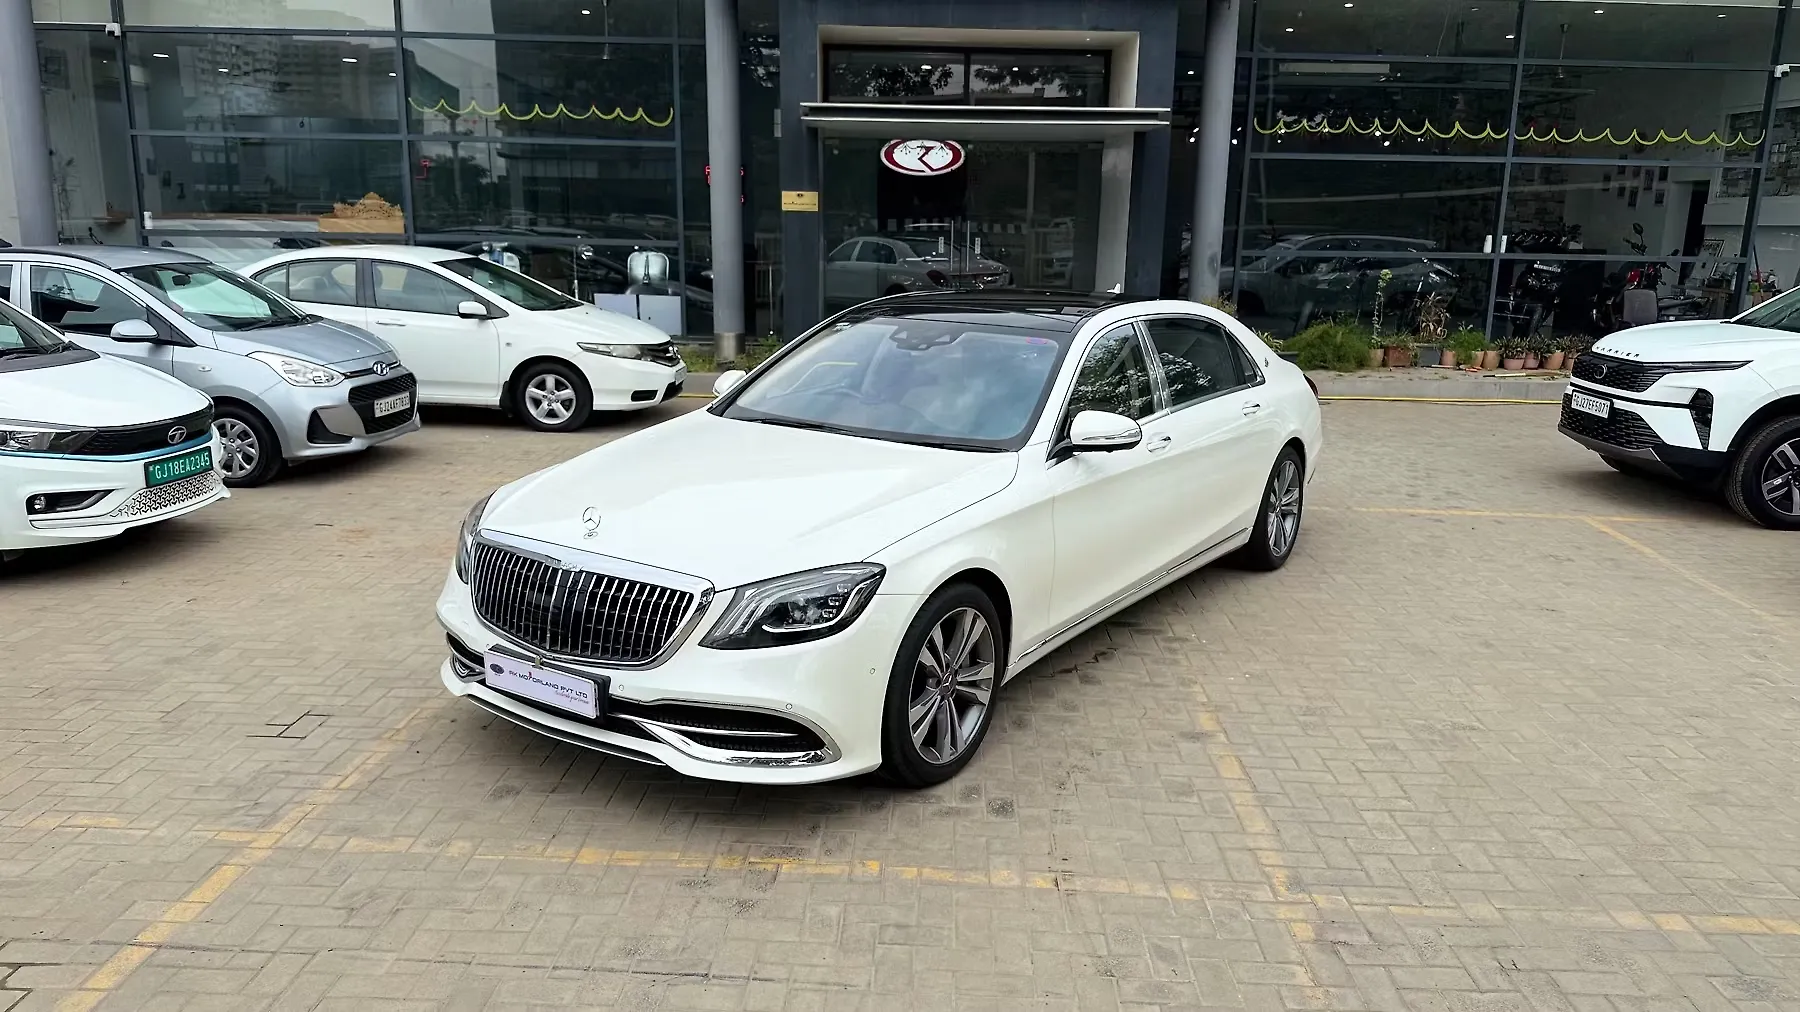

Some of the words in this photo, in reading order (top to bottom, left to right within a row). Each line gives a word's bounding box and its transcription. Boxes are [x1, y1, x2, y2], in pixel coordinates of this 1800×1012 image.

[155, 452, 210, 479] GJ18EA2345
[518, 671, 559, 690] MOTORLAND
[560, 685, 574, 694] PVT
[575, 690, 588, 699] LTD
